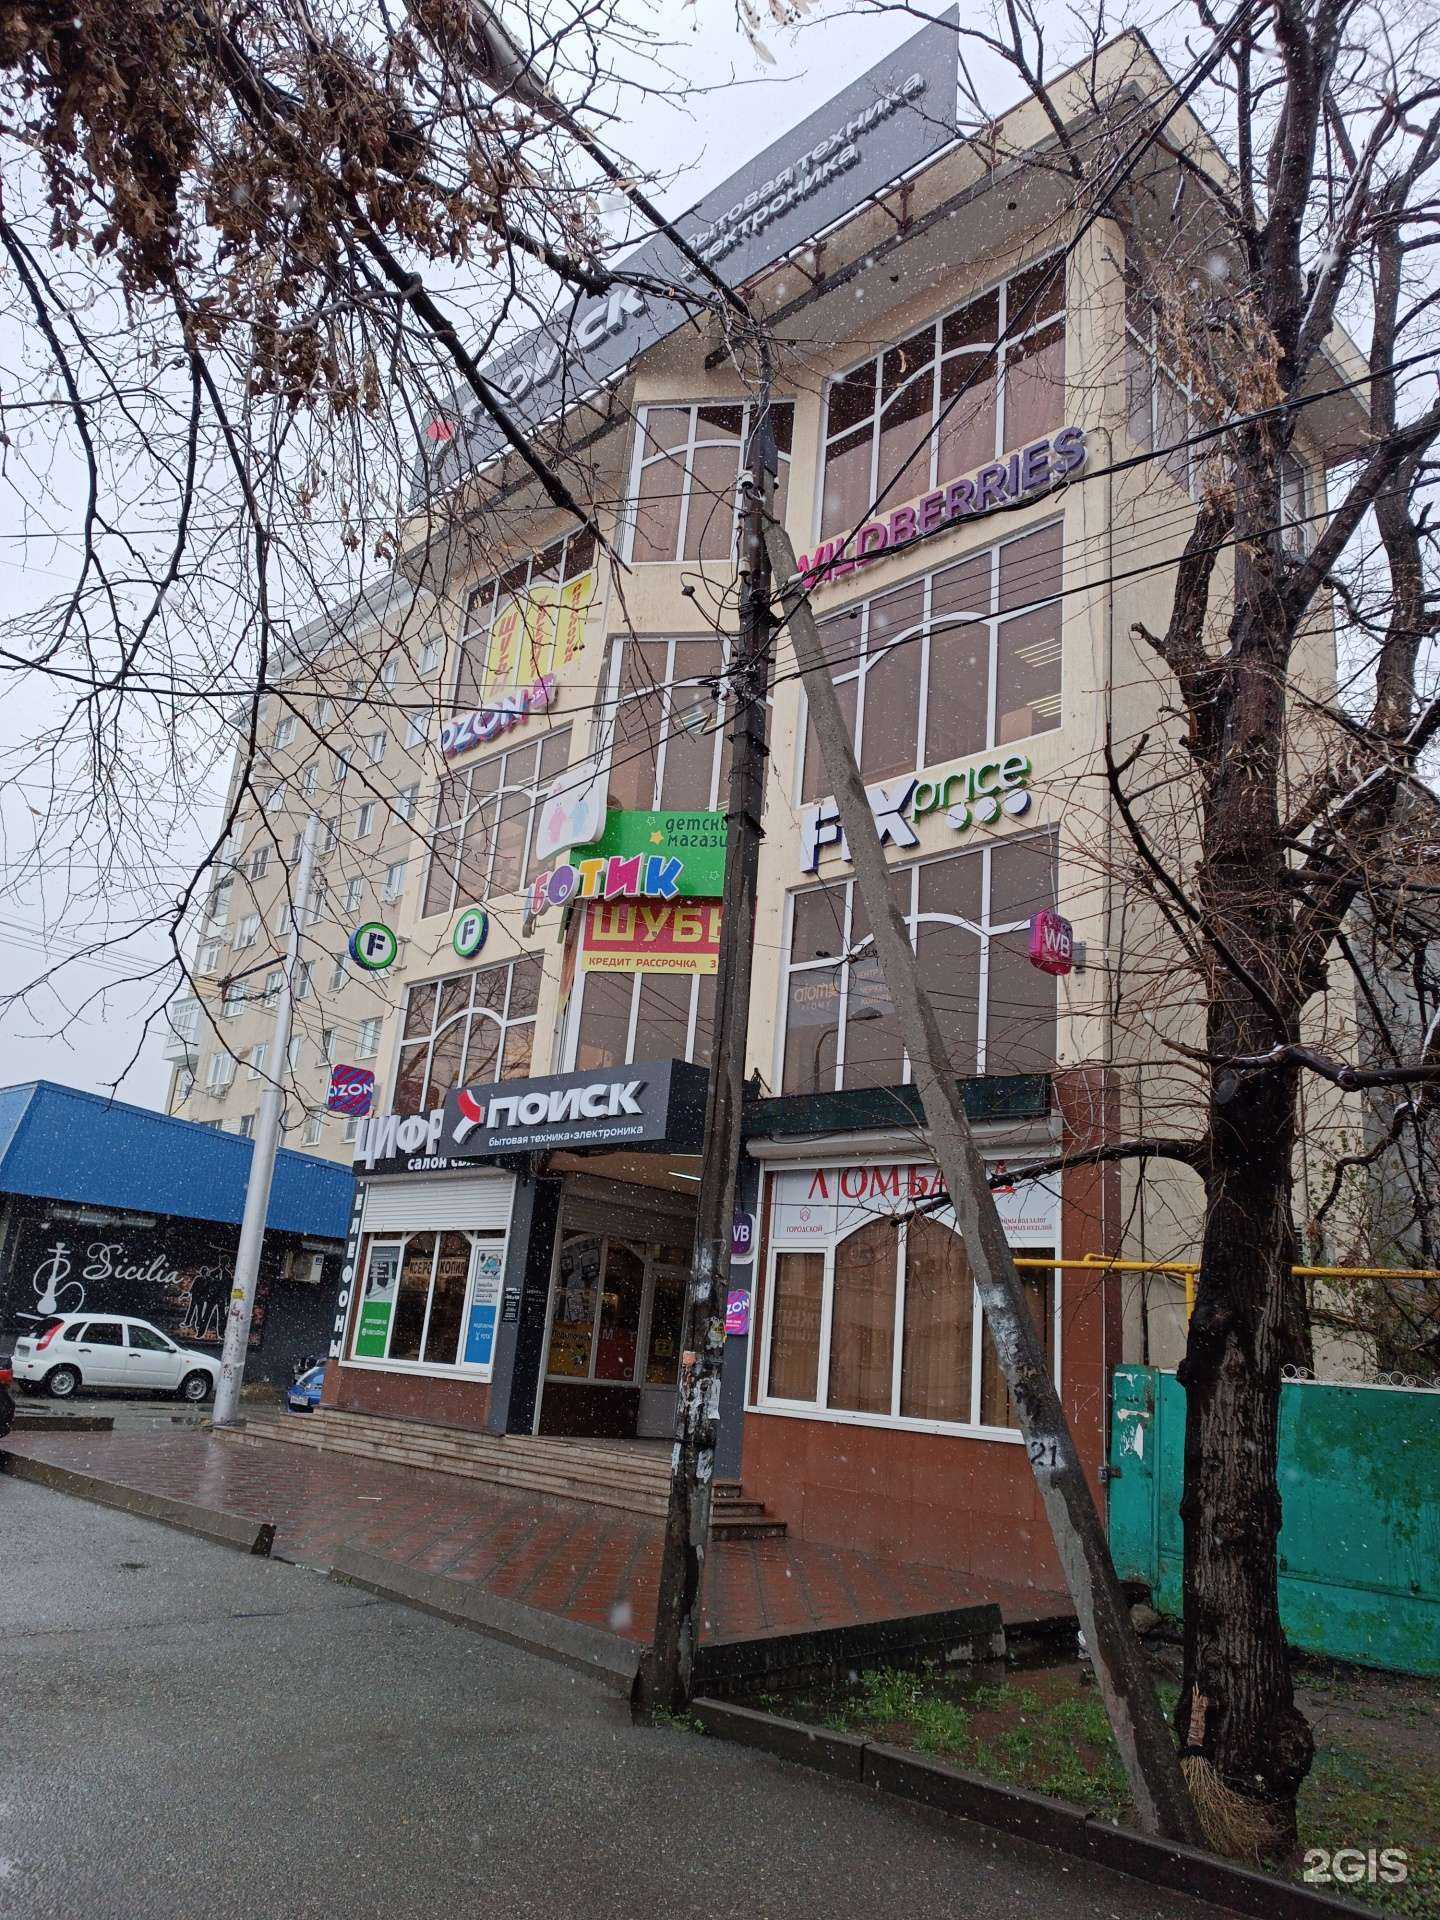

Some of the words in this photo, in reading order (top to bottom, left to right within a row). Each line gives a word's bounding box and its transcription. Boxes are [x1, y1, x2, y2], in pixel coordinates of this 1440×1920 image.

[665, 817, 728, 832] детски
[667, 834, 728, 848] магази
[530, 852, 684, 916] БОТИК
[1044, 925, 1070, 958] WB
[588, 956, 631, 967] КРЕДИТ
[635, 958, 697, 969] РАССРОЧКА
[328, 1082, 374, 1097] OZON
[486, 1080, 643, 1129] ПОИСК
[488, 1136, 528, 1147] бытовая
[530, 1133, 570, 1143] техника
[573, 1125, 644, 1141] электроника
[407, 1158, 447, 1171] салон
[786, 1224, 823, 1233] ГОРОДСКОЙ
[82, 1242, 184, 1284] Sicilia
[726, 1299, 750, 1315] ZON
[1030, 1441, 1057, 1466] 21
